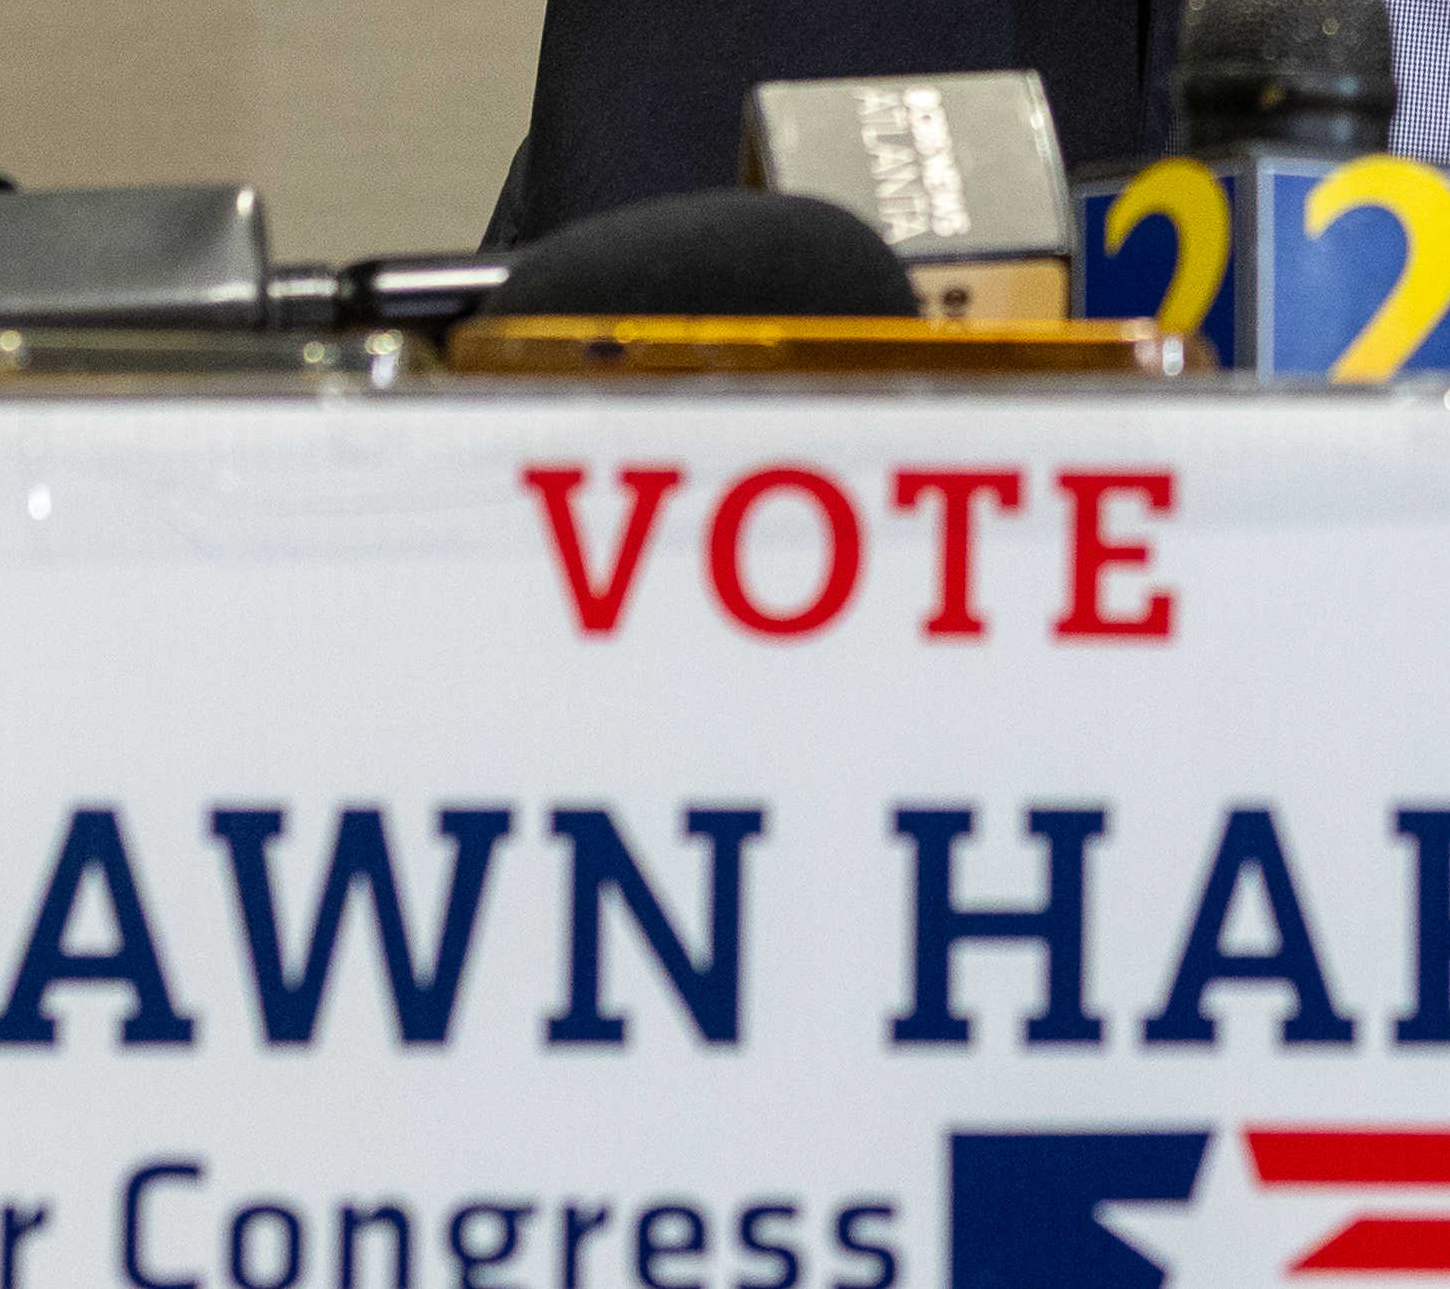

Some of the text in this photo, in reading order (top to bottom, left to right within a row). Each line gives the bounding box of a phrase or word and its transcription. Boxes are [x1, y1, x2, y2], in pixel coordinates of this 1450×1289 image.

[851, 86, 929, 245] ATLANTA
[1103, 156, 1232, 340] 2
[522, 465, 1177, 642] VOTE
[120, 1160, 900, 1289] Congress
